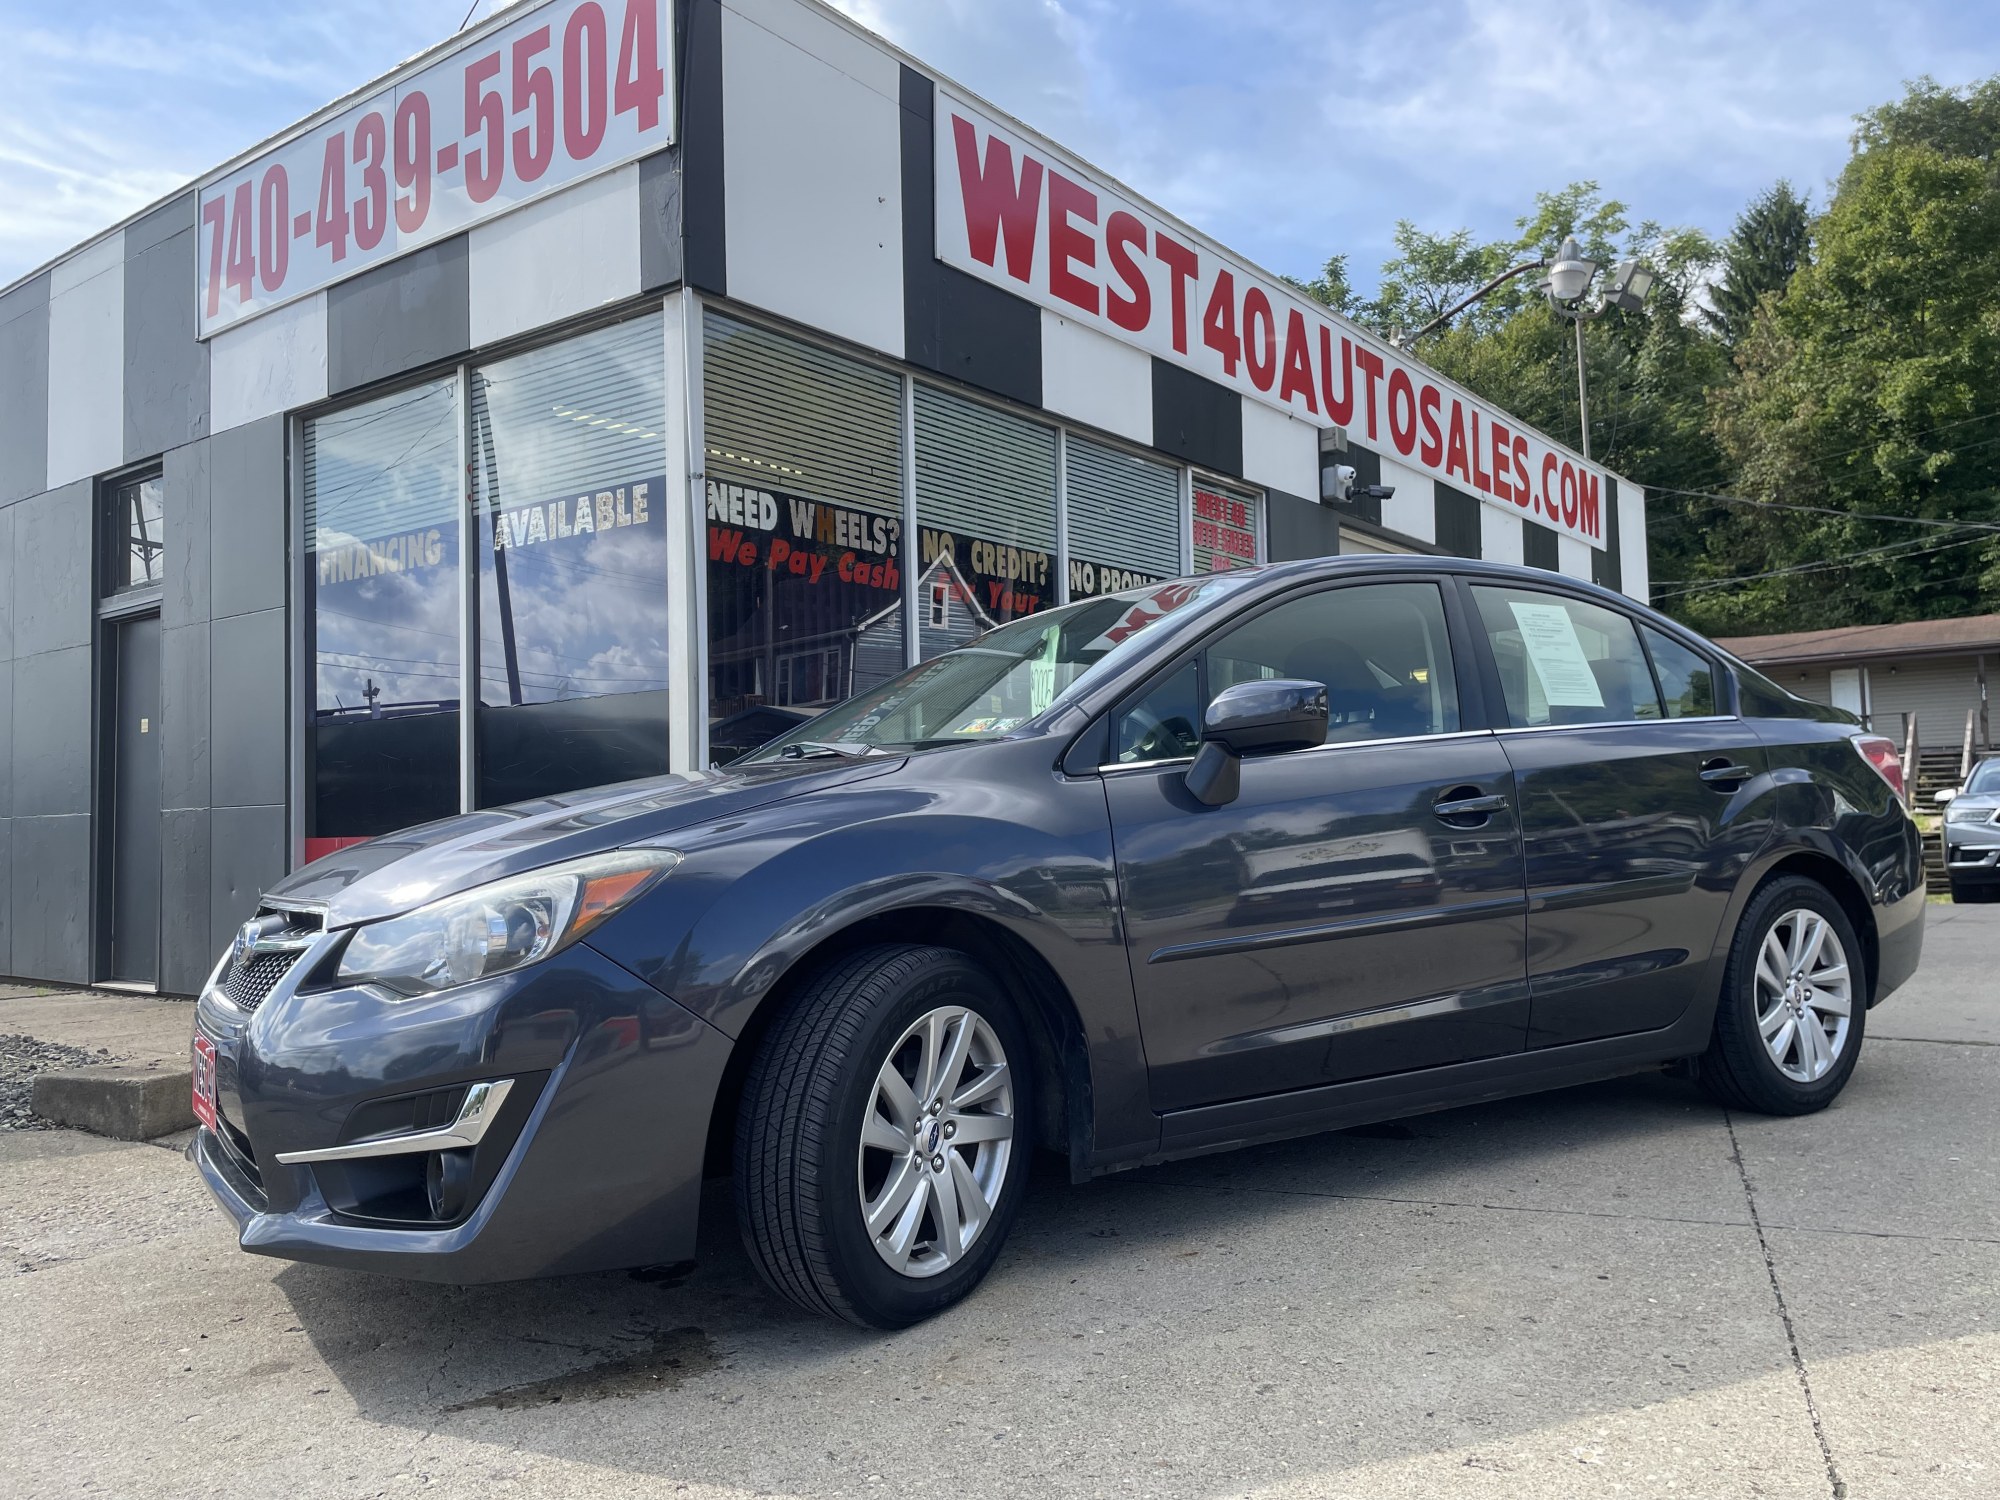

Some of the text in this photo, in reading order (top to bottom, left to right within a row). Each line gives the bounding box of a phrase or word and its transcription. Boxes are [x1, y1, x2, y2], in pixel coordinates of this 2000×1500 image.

[203, 0, 664, 319] 740-439-5504
[951, 112, 1600, 540] WEST40AUTOSALES.COM
[493, 483, 649, 551] AVAILABLE
[706, 480, 900, 557] NEED WHEELS?
[1195, 490, 1246, 528] WEST 40
[319, 528, 442, 587] FINANCING
[708, 526, 900, 591] We Pay Cash
[922, 528, 1049, 587] NO CREDIT?
[1221, 527, 1255, 559] SALES
[988, 580, 1040, 615] Your
[1069, 560, 1095, 594] NO
